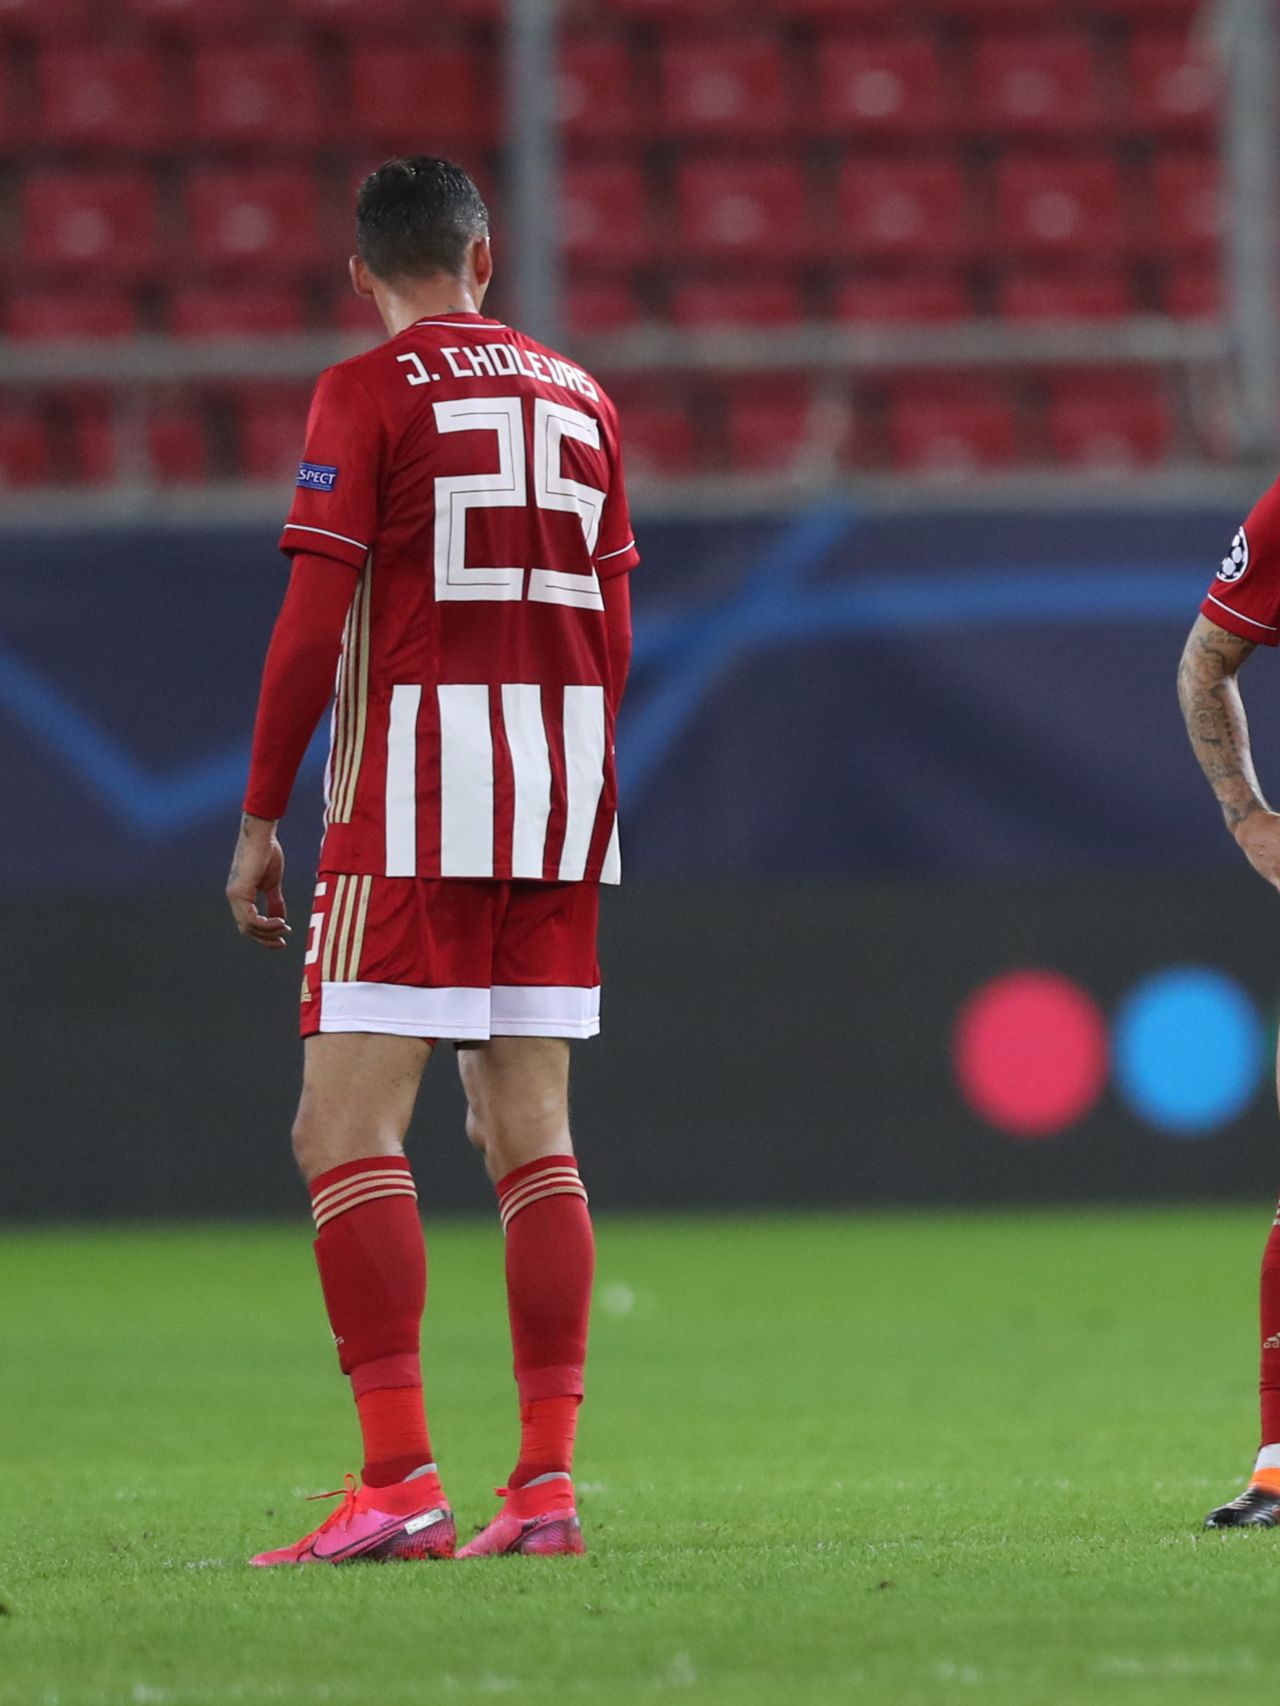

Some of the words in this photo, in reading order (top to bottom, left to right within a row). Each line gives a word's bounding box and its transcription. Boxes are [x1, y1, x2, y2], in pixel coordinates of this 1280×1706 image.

[396, 351, 441, 386] J.
[297, 468, 337, 485] SPECT
[432, 396, 607, 612] 25
